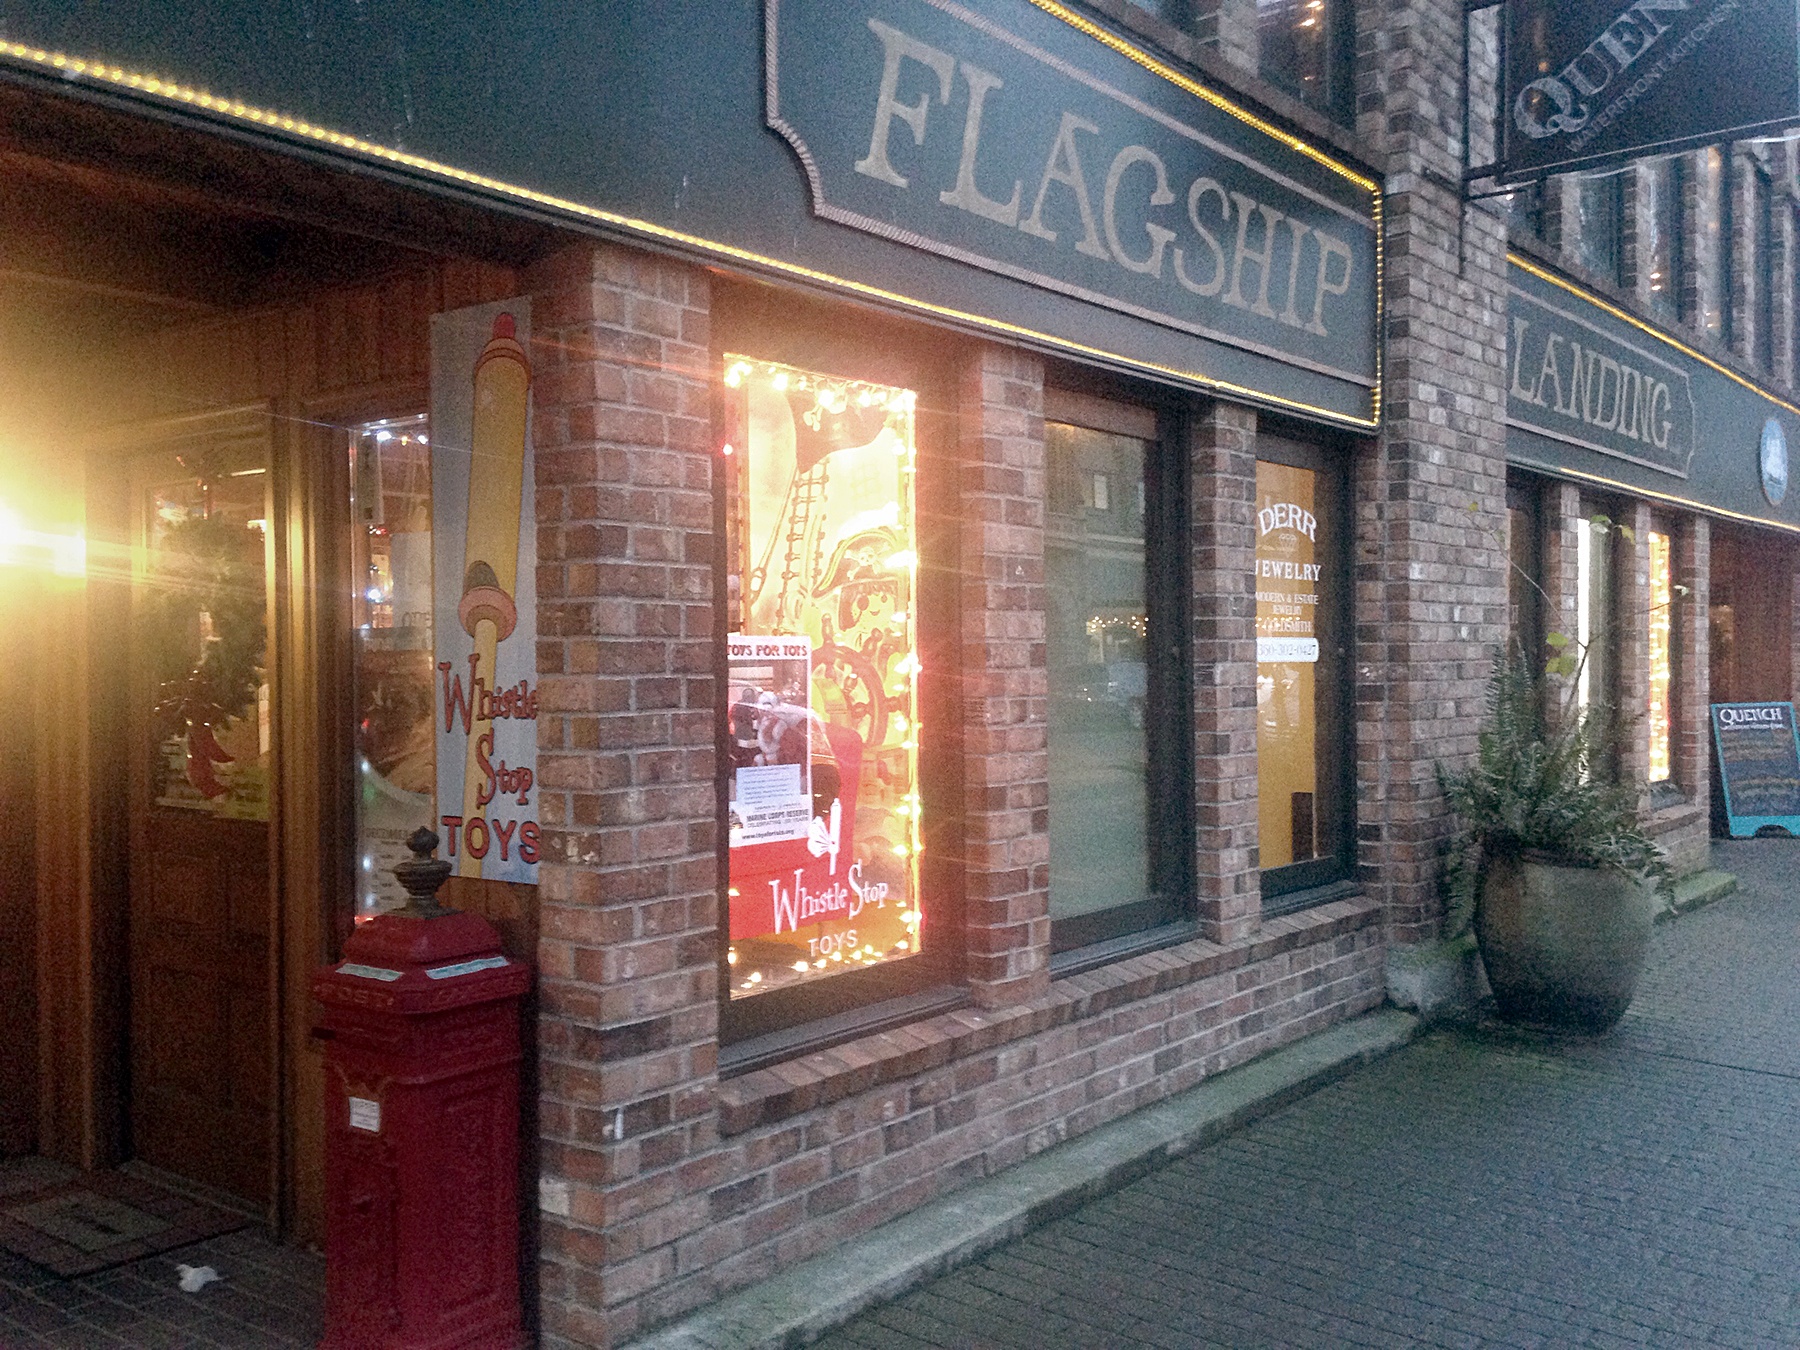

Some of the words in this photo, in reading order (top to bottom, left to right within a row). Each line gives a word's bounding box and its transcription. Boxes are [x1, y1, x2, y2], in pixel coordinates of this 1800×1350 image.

[854, 18, 1352, 337] FLAGSHIP
[1510, 316, 1672, 449] LANDING
[1257, 503, 1318, 542] DERR
[1255, 559, 1322, 582] JEWELRY
[1294, 593, 1319, 605] ESTATE
[727, 644, 752, 657] TOYS
[756, 644, 780, 657] FOR
[782, 644, 807, 657] TOTS
[438, 653, 537, 735] Whistle
[1720, 708, 1783, 726] QUENCH
[476, 727, 534, 809] Stop
[442, 815, 541, 864] TOYS
[768, 868, 848, 935] Whistle
[848, 859, 888, 920] Stop
[808, 929, 858, 957] TOYS
